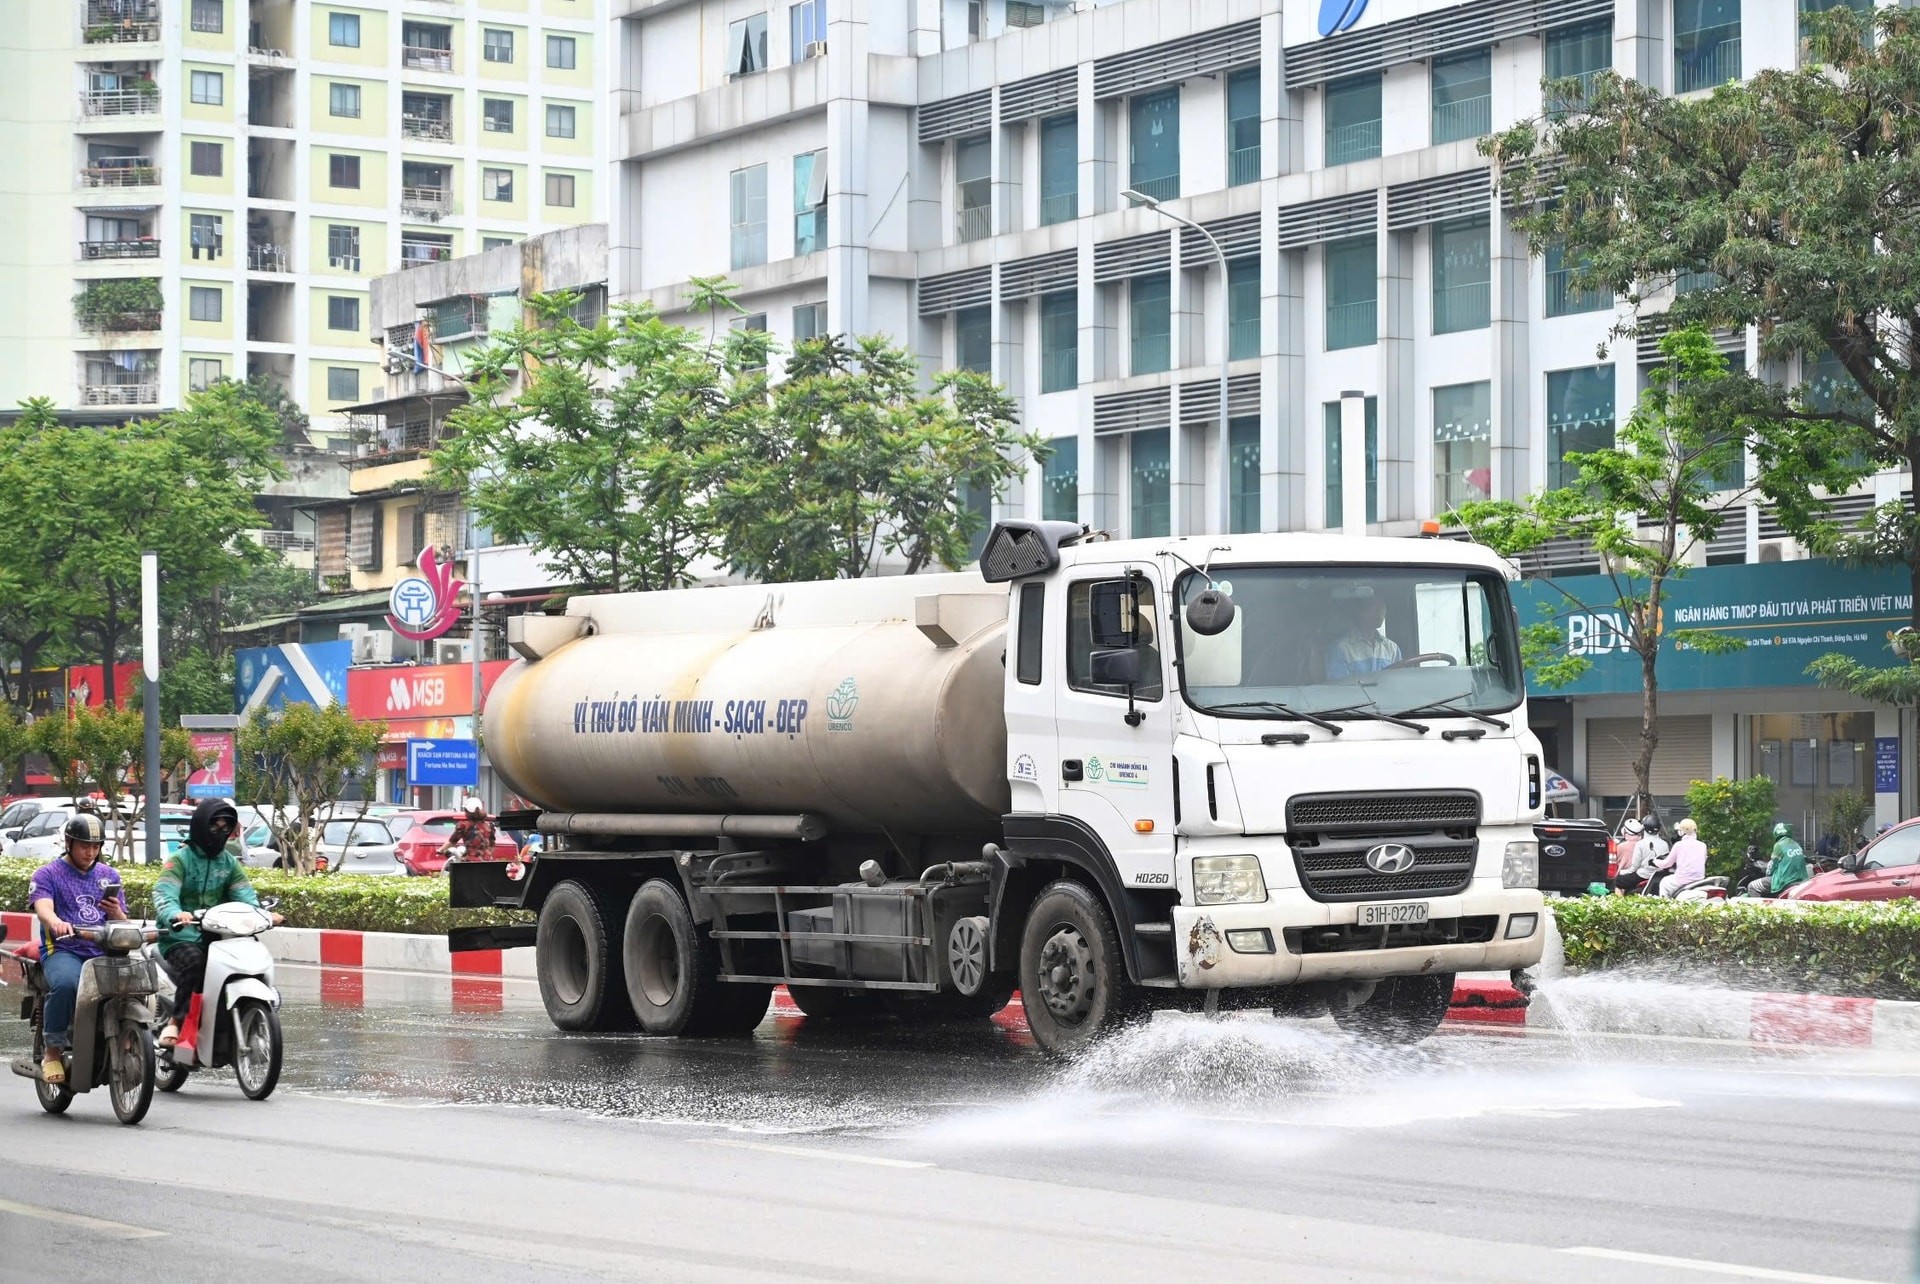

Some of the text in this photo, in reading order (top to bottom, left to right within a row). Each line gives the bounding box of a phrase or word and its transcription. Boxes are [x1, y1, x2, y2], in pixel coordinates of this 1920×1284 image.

[1675, 606, 1700, 623] NGÂN
[1703, 604, 1729, 621] HÀNG
[1731, 604, 1757, 619] TMCP
[1760, 601, 1779, 617] ĐẦU
[1781, 601, 1796, 616] TƯ
[1796, 598, 1809, 615] VÀ
[1811, 596, 1837, 615] PHÁT
[1839, 594, 1868, 613] TRIỂN
[1870, 593, 1893, 613] VIỆT
[1568, 613, 1636, 655] BIDV
[412, 679, 445, 707] MSB
[574, 695, 588, 733] VÌ
[591, 691, 618, 733] THỦ
[618, 694, 637, 733] ĐÔ
[641, 694, 671, 733] VĂN
[673, 700, 714, 733] MINH
[724, 700, 766, 740] SẠCH
[776, 699, 808, 740] ĐẸP
[827, 722, 852, 731] URENCO
[1135, 873, 1169, 884] HD260
[1366, 905, 1424, 923] 31H-0270
